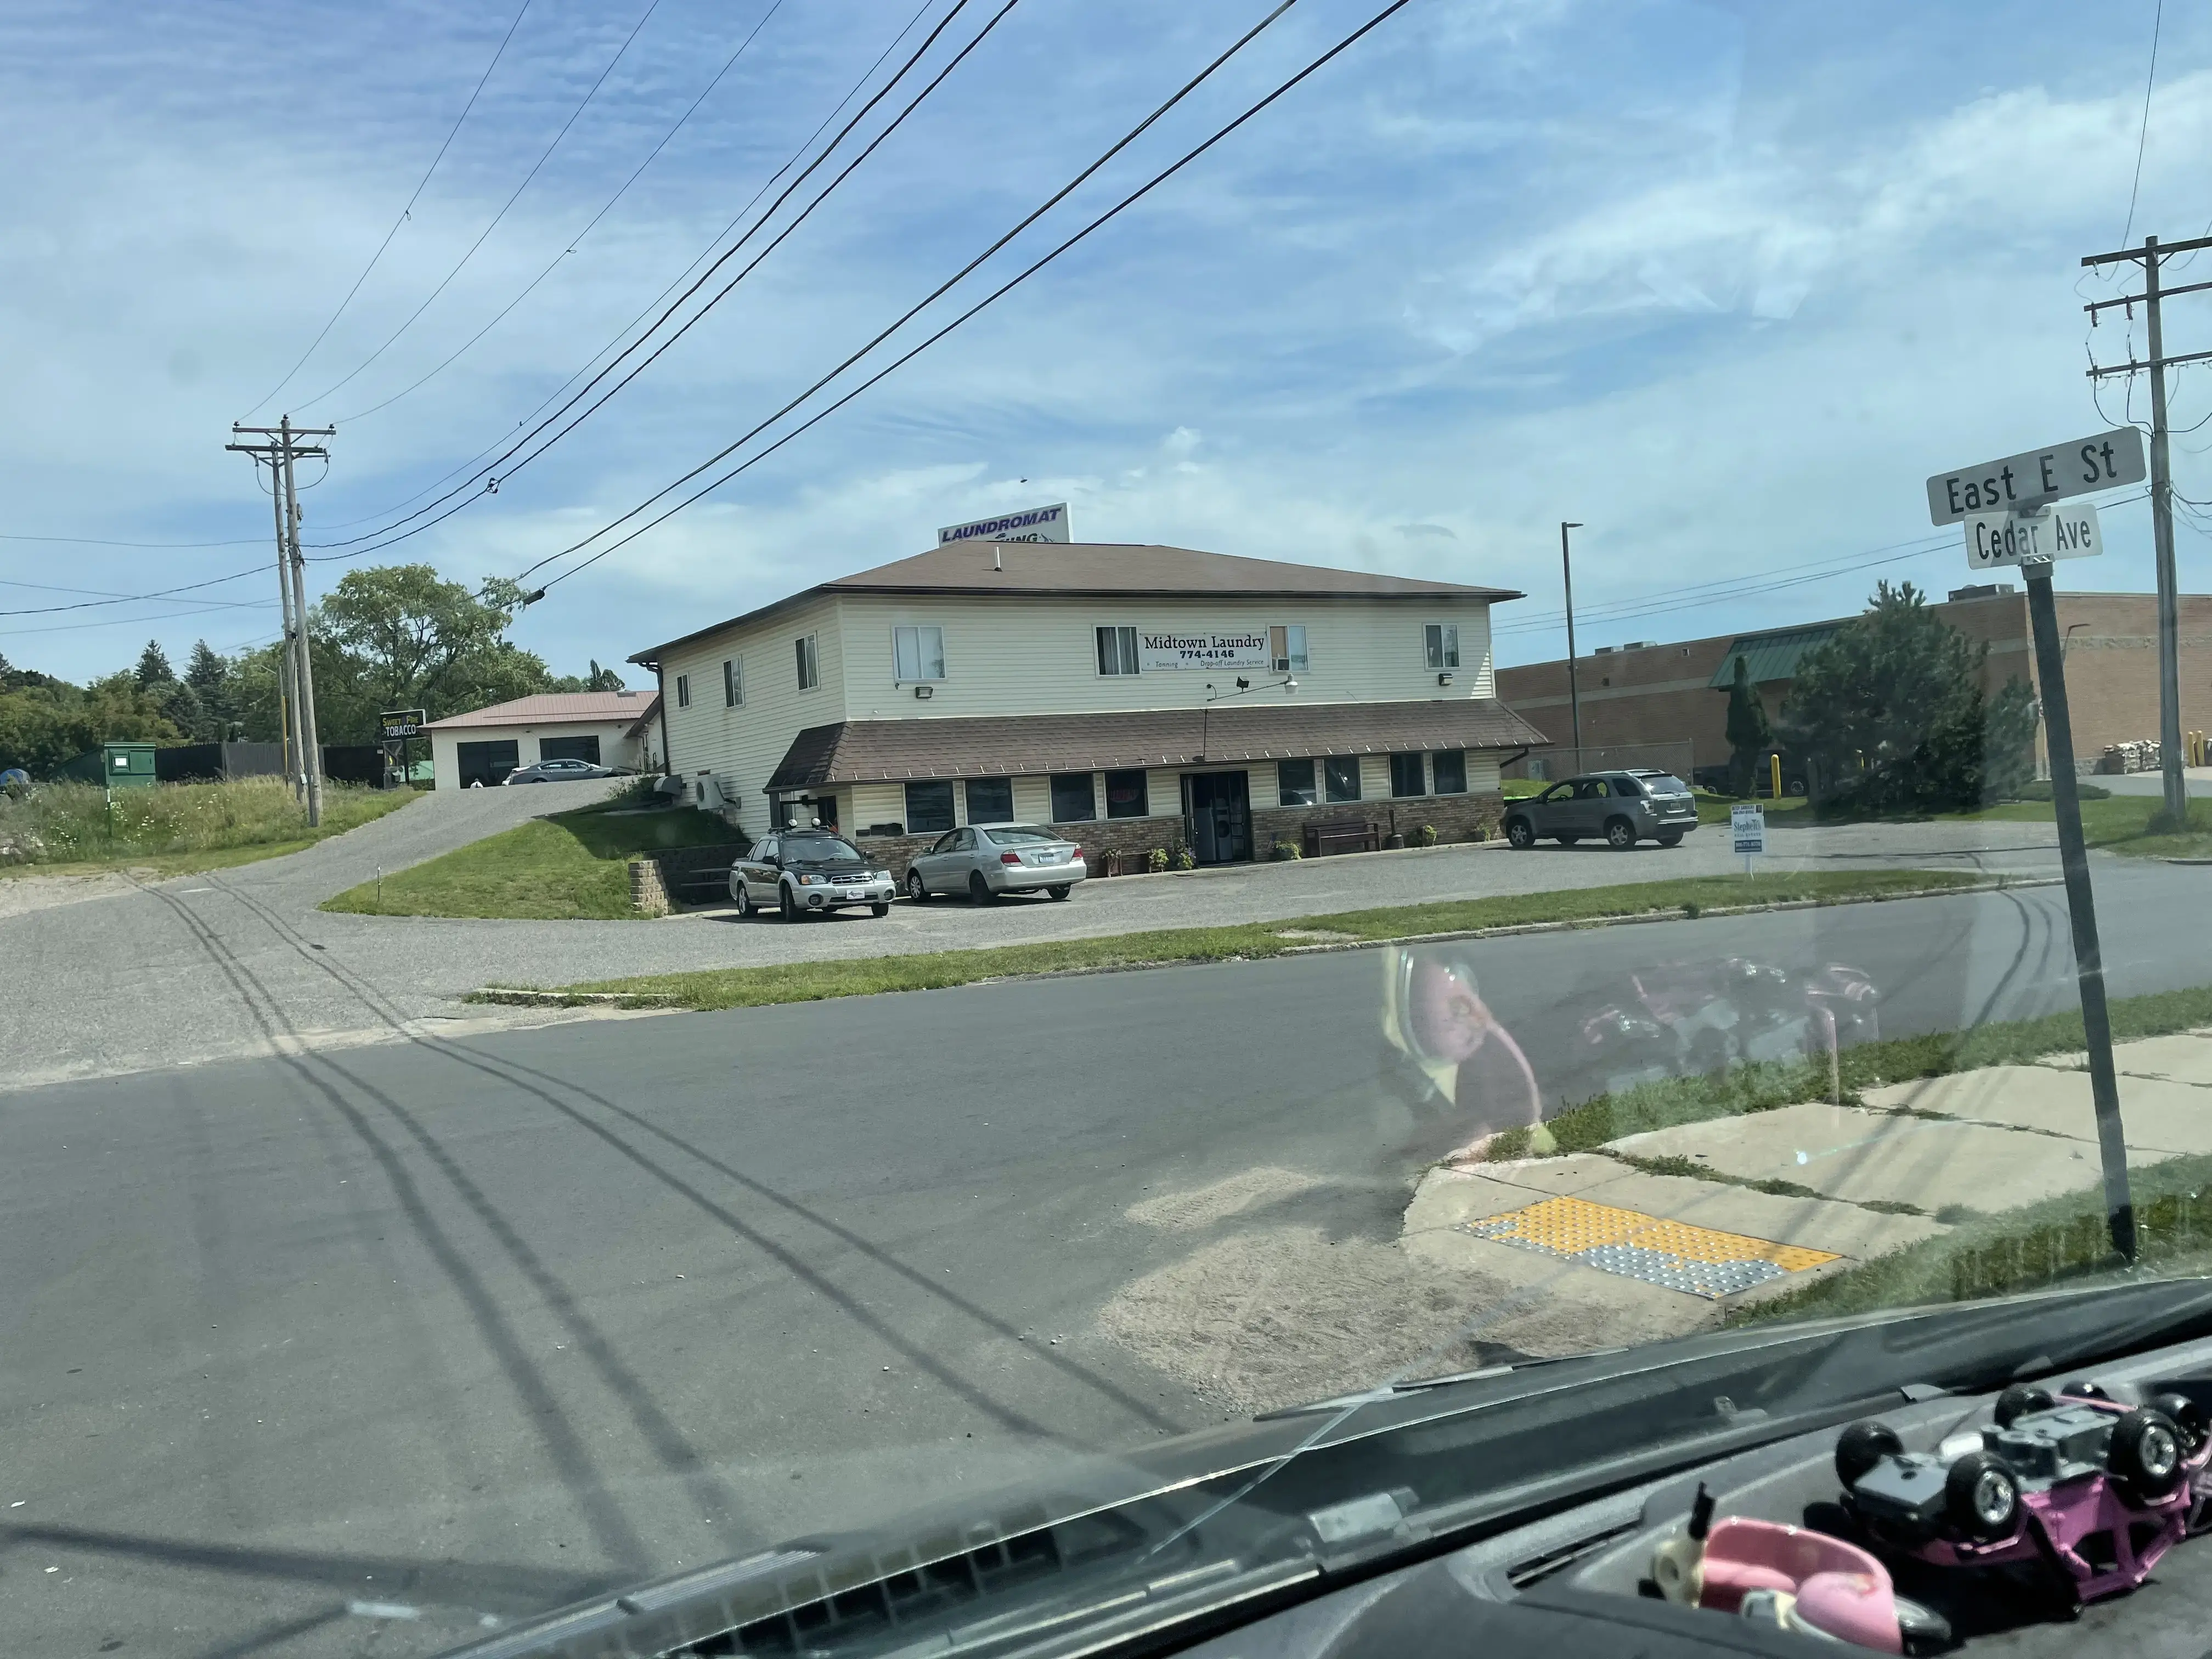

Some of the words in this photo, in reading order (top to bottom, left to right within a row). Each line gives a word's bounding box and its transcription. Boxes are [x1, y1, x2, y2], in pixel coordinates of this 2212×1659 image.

[1946, 465, 2016, 514] East
[2039, 454, 2058, 493] E
[2081, 441, 2117, 483] St
[941, 507, 1063, 543] LAUNDROMAT
[1976, 520, 2038, 560] Cedar
[2056, 515, 2091, 551] Ave
[1144, 635, 1207, 649] Midtown
[1211, 634, 1265, 651] Laundry
[1180, 650, 1234, 659] 774-4146
[385, 724, 416, 737] TOBACCO
